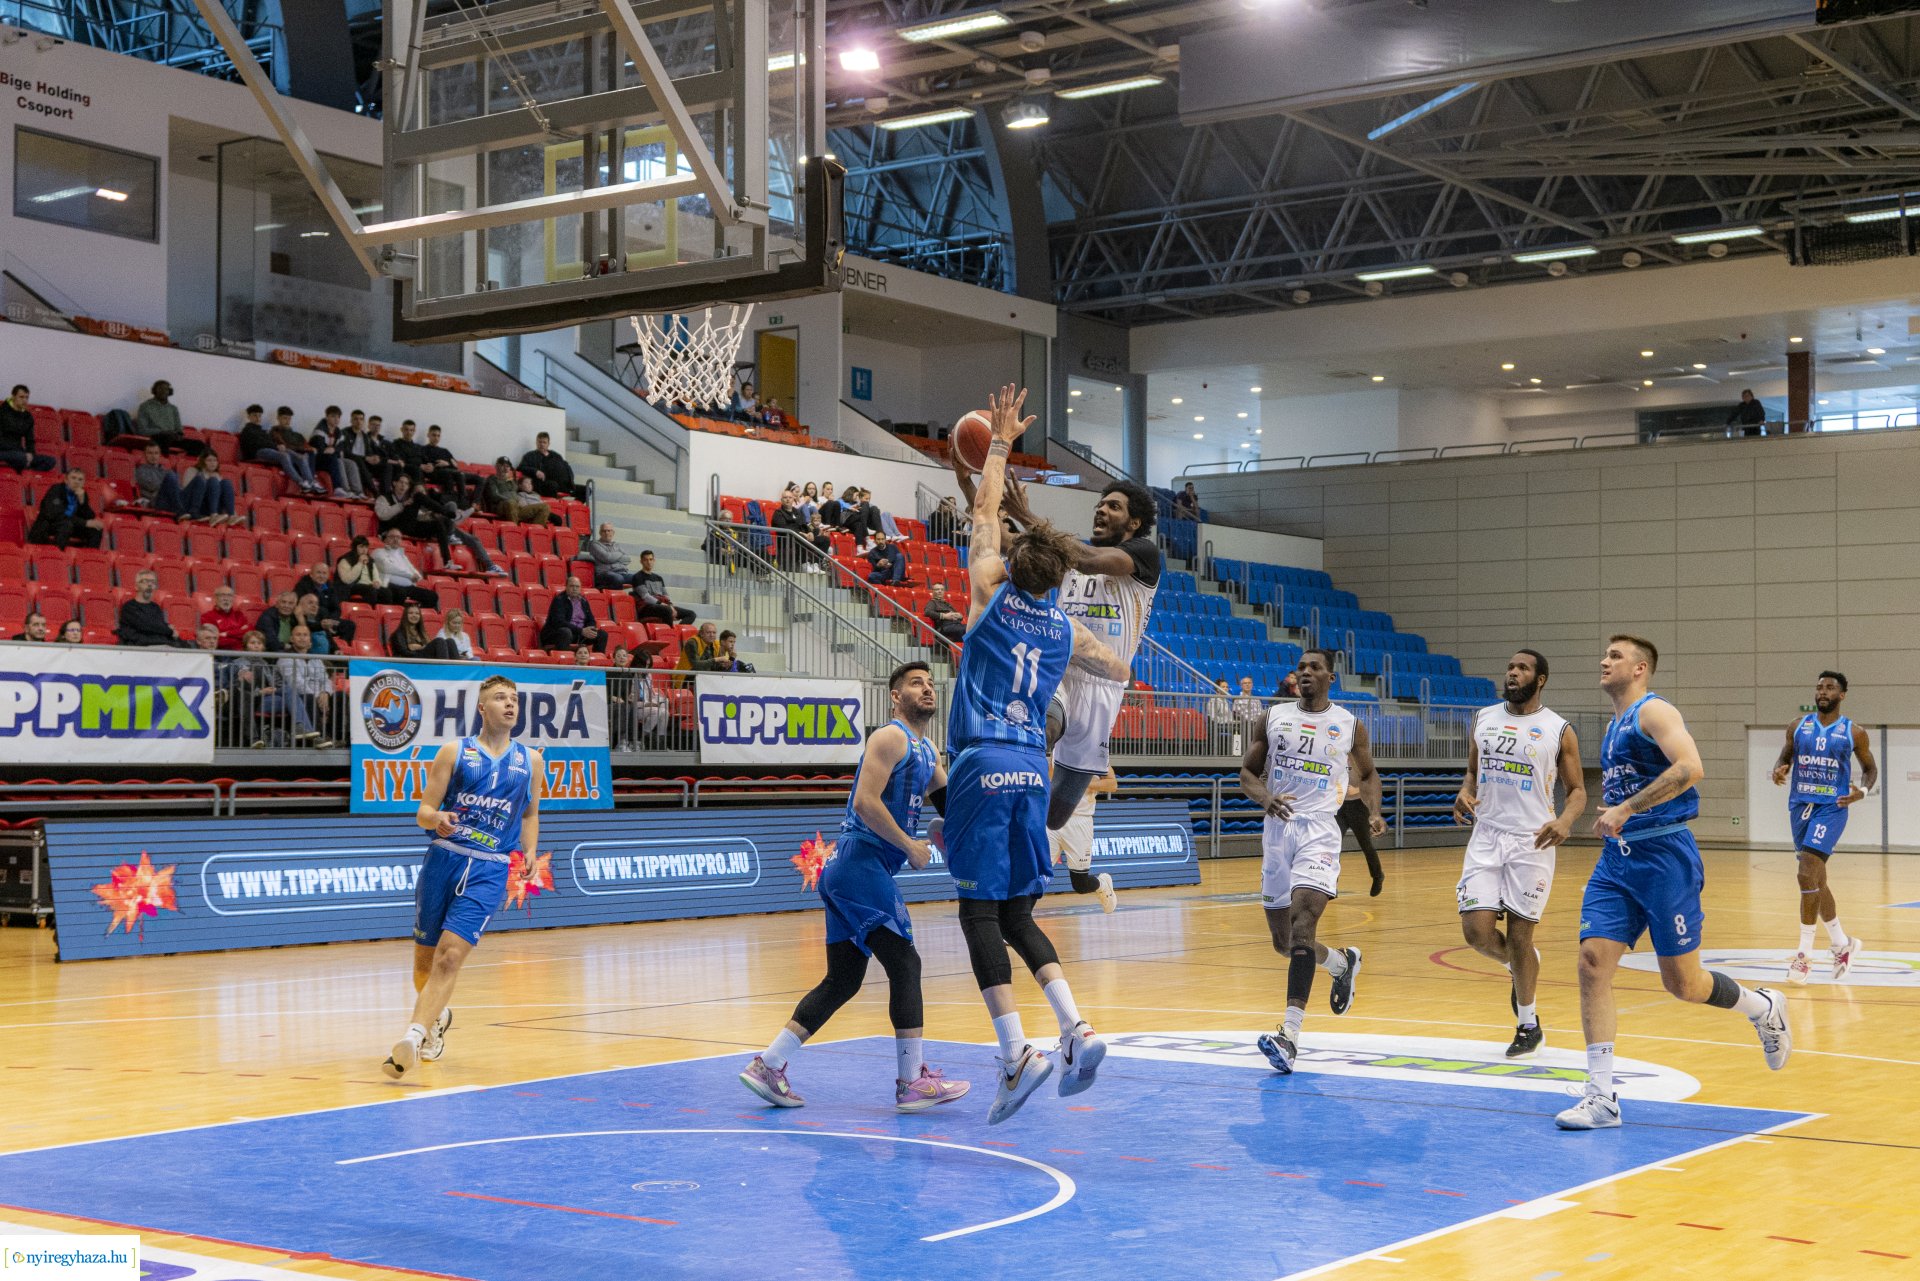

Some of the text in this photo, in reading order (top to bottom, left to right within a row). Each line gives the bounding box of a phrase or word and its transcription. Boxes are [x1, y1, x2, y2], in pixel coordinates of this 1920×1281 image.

[0, 72, 90, 107] Bige Holding
[17, 96, 73, 119] Csoport
[842, 266, 887, 293] BNER
[1083, 578, 1097, 598] 0
[1001, 614, 1062, 640] KAPOSVÁR
[1010, 642, 1042, 698] 11
[434, 681, 590, 739] HJRÁ
[1297, 735, 1315, 756] 21
[1495, 735, 1517, 756] 22
[1816, 736, 1827, 751] 13
[1798, 755, 1839, 769] KOMETA
[491, 771, 500, 790] 1
[981, 771, 1044, 789] KOMETA
[457, 793, 512, 814] KOMETA
[1813, 824, 1827, 839] 13
[583, 852, 750, 881] WWW.TIPPMIXPRO.HU
[1674, 914, 1688, 936] 8
